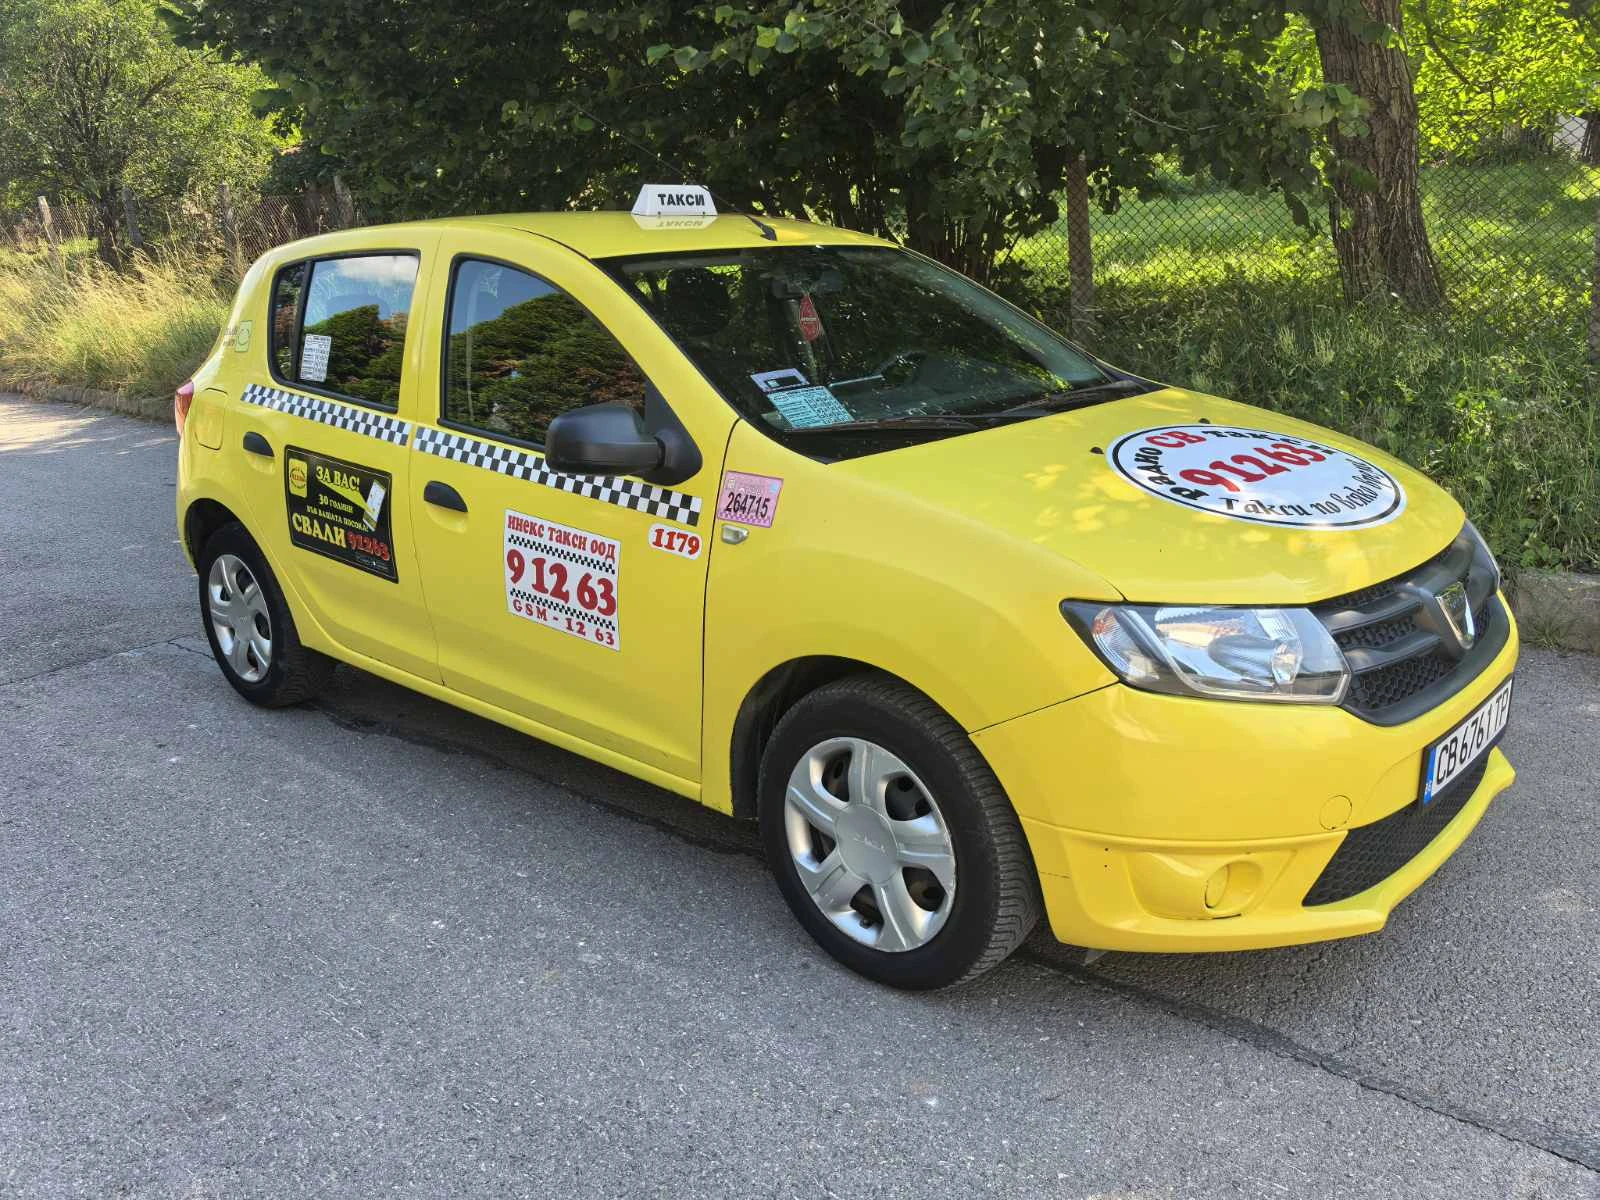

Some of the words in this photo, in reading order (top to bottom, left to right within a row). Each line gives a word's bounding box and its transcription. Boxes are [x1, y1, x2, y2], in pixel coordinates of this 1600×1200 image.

[657, 193, 705, 206] ТАКСИ
[1145, 431, 1207, 449] СВ
[315, 466, 331, 483] ЗА
[333, 470, 360, 491] ВАС!
[1179, 443, 1327, 492] 91263
[319, 494, 329, 505] 30
[724, 491, 771, 518] 264715
[1310, 500, 1342, 516] по
[292, 512, 347, 549] СВАЛИ
[652, 528, 700, 556] 1179
[512, 599, 548, 622] GSM
